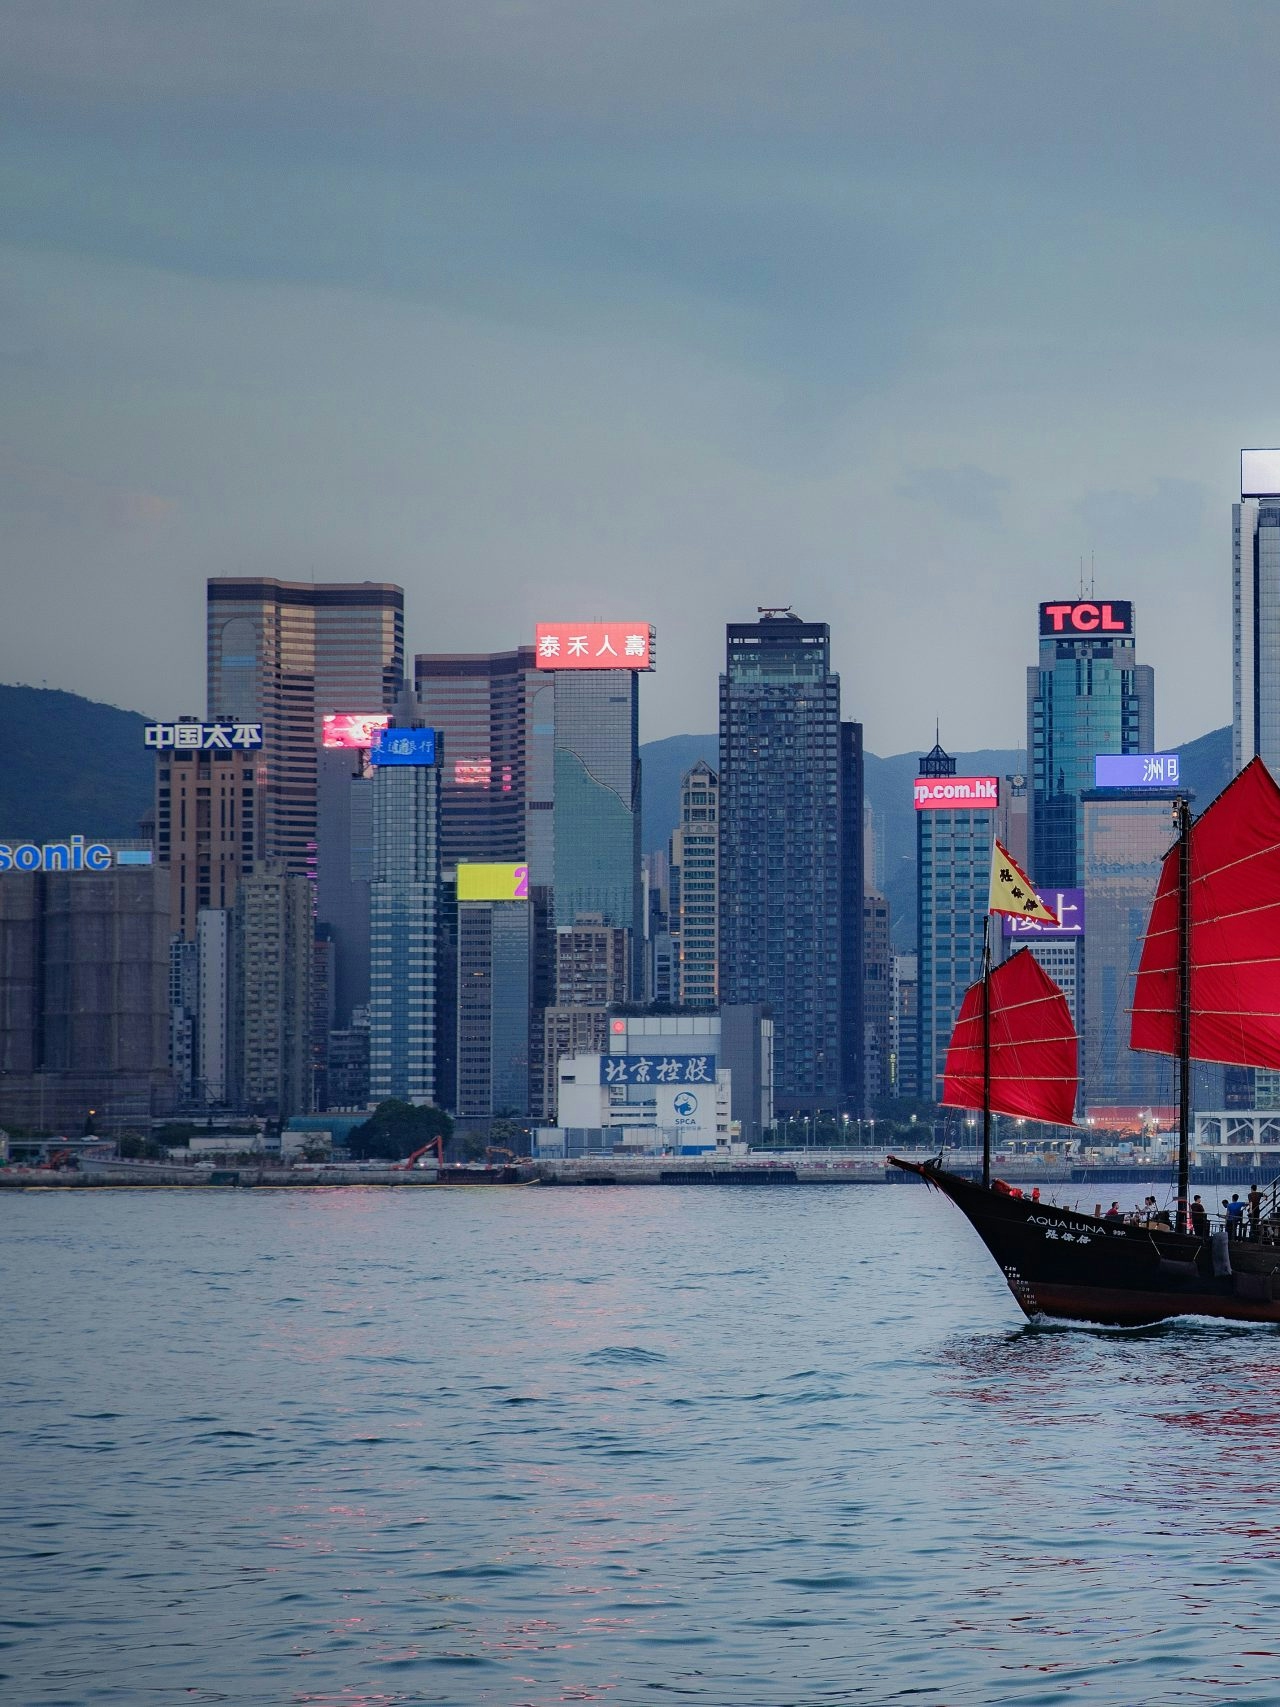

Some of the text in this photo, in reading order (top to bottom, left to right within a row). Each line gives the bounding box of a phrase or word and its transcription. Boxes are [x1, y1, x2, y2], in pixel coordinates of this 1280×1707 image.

[1046, 604, 1124, 631] TCL
[539, 634, 646, 657] 泰禾人壽
[144, 724, 262, 749] 中国太平
[675, 1118, 696, 1126] SPCA
